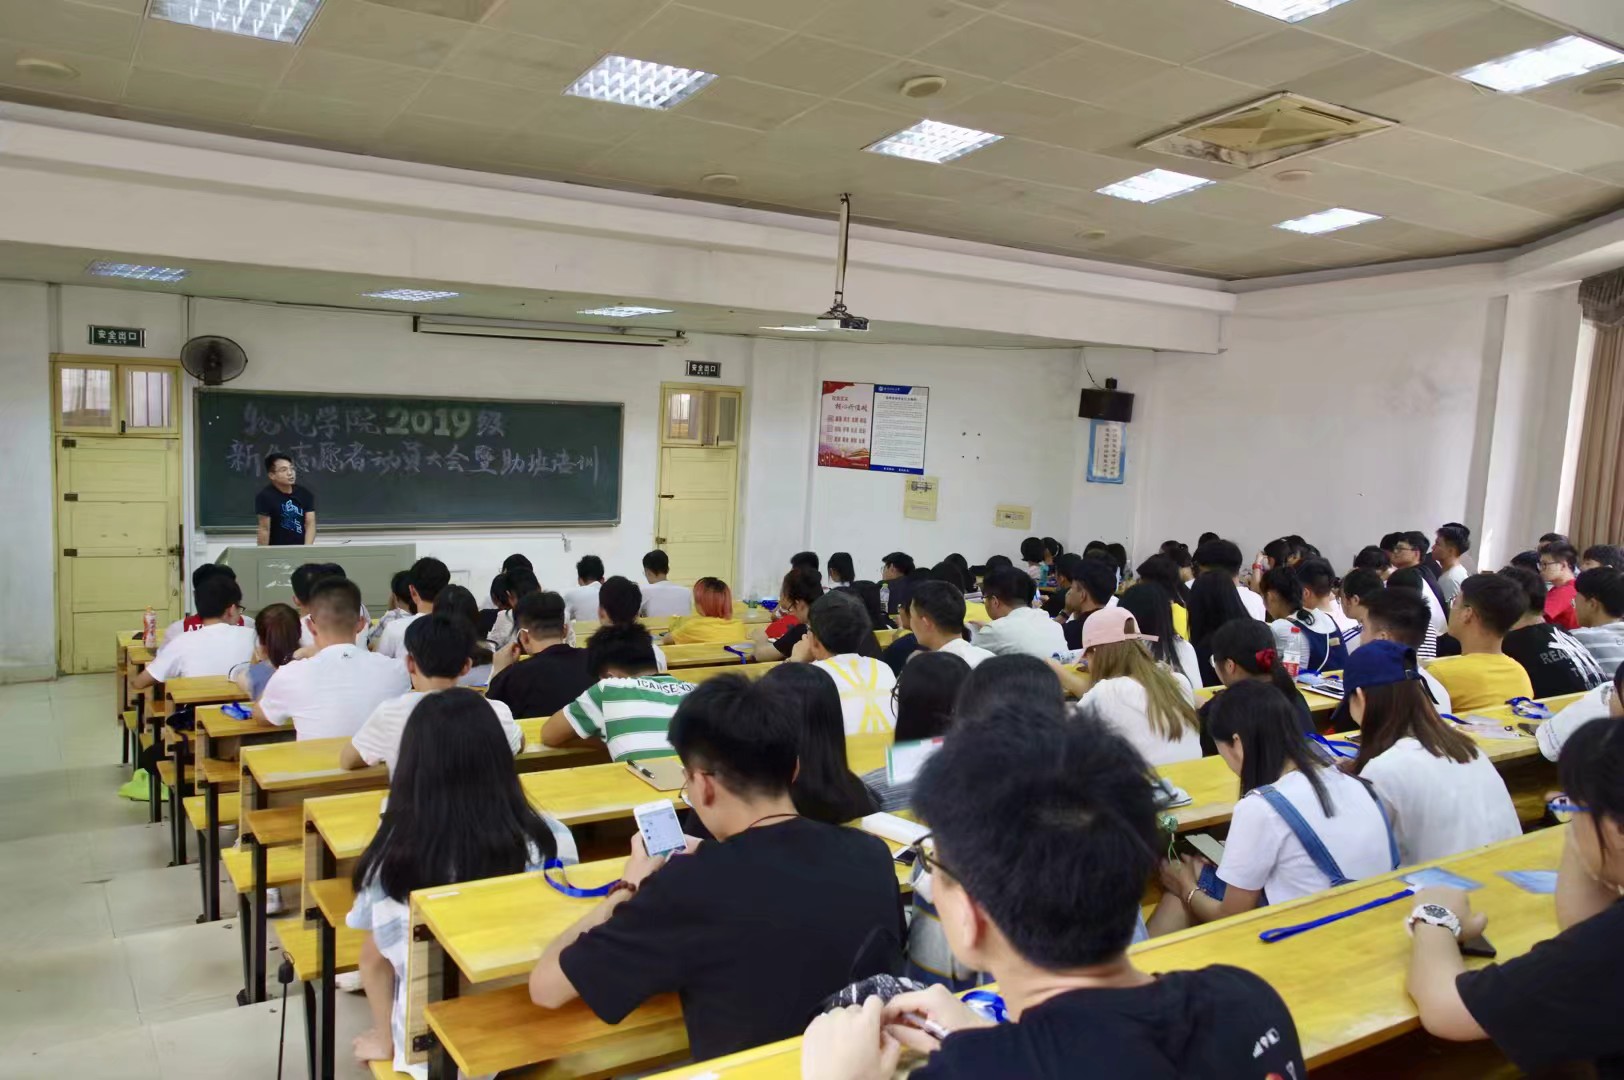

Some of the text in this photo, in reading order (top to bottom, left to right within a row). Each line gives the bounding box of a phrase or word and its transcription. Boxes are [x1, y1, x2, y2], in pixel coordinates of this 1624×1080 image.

[97, 329, 137, 340] 安全出口
[691, 364, 716, 372] 安全出口
[226, 438, 599, 487] 新志愿者动员大会暨助班培训
